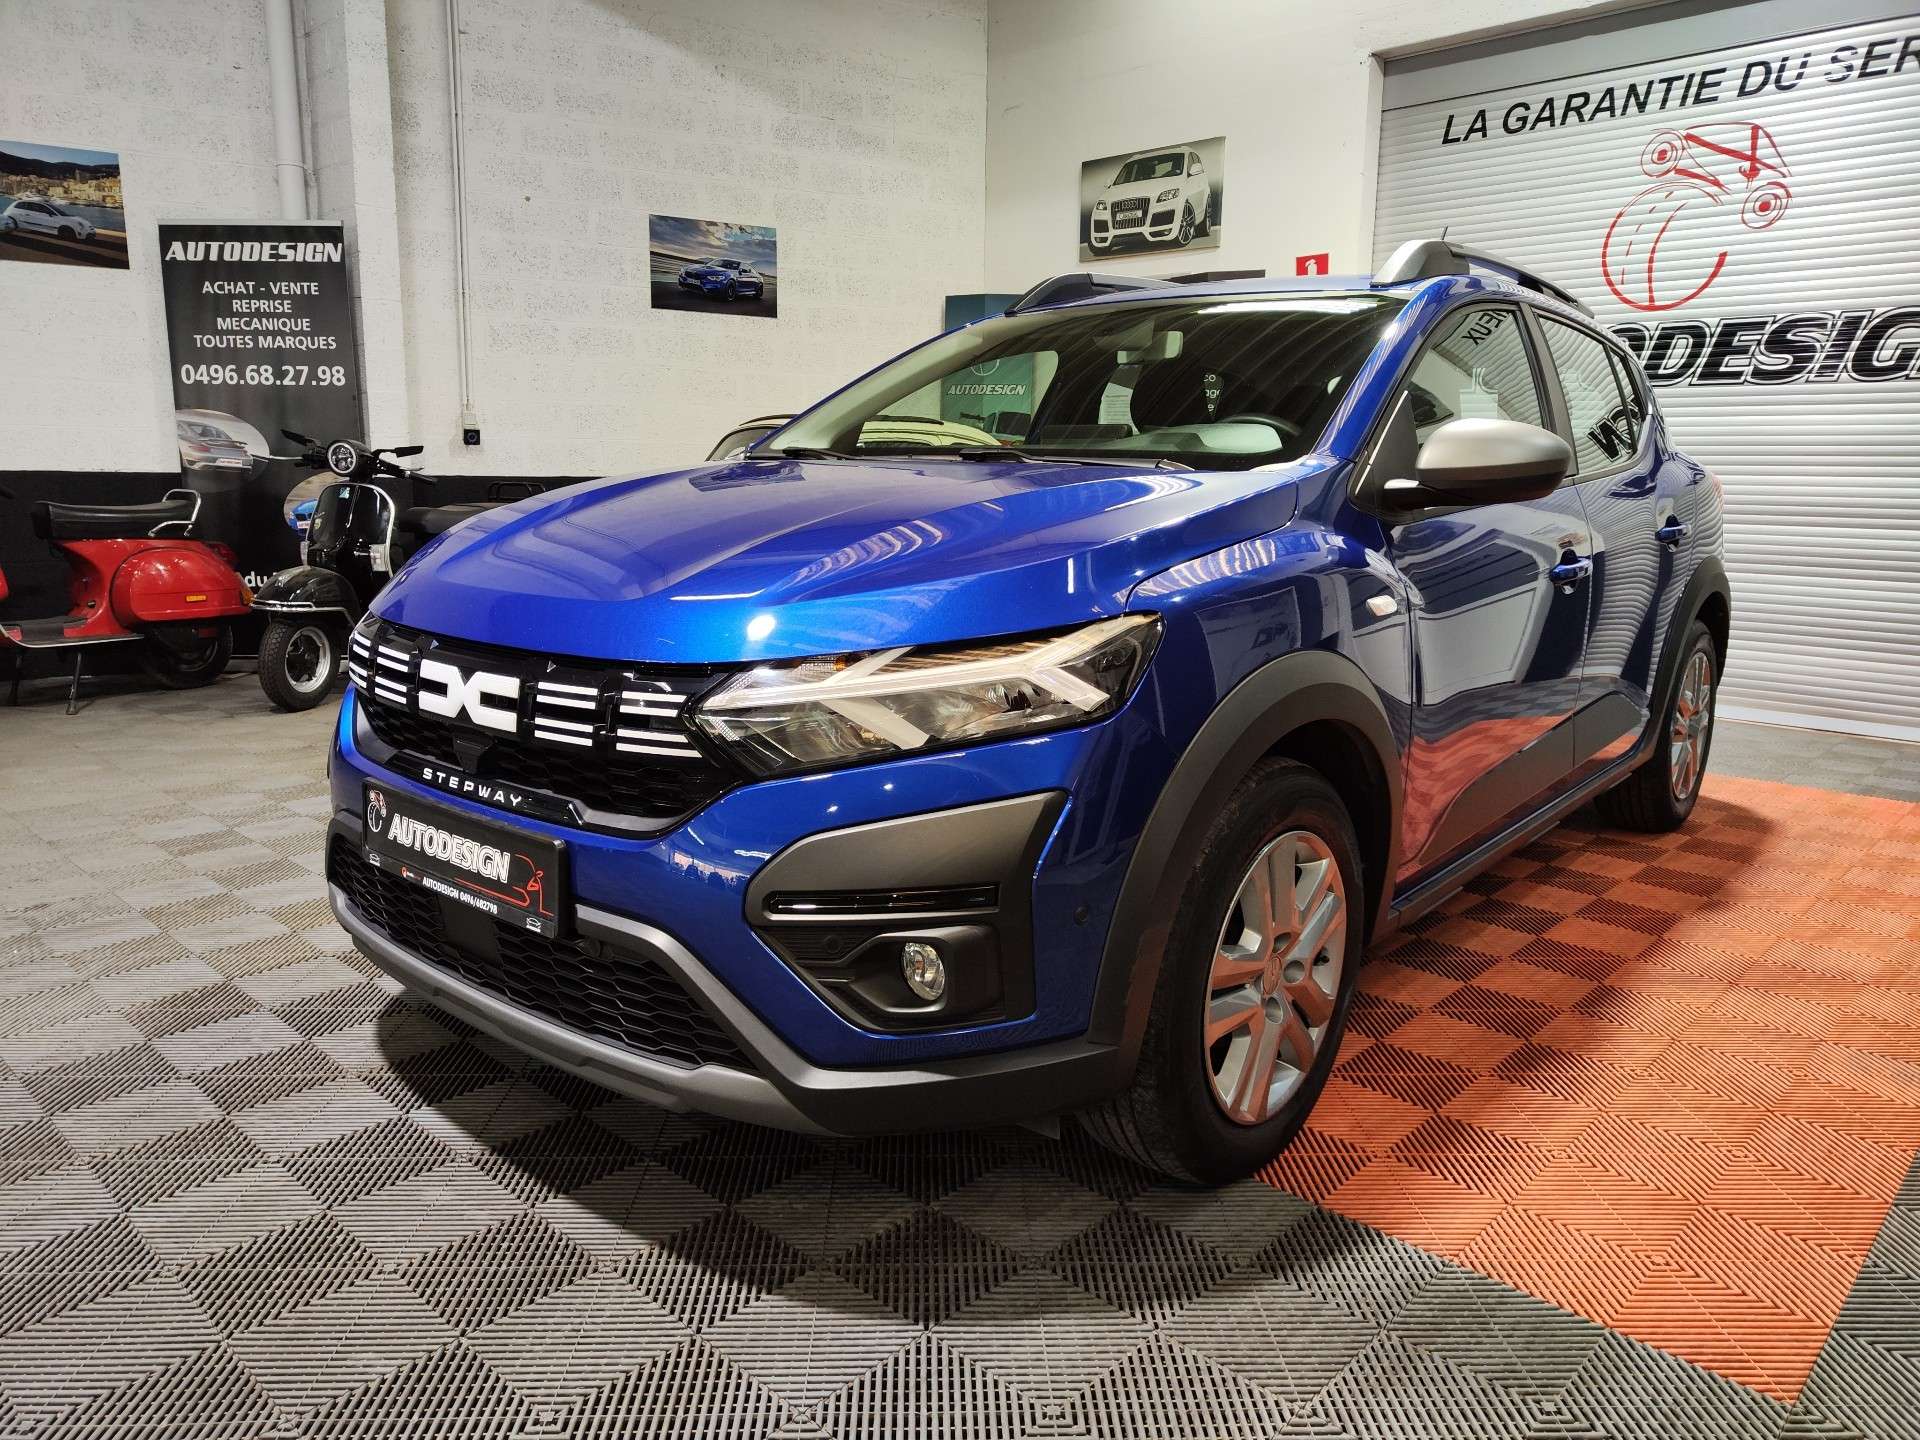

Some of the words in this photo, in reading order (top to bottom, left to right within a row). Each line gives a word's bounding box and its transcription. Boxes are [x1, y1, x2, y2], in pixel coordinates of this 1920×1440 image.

[1442, 109, 1488, 145] LA
[1502, 67, 1728, 135] GARANTIE
[1737, 52, 1811, 98] DU
[165, 241, 343, 263] AUTODESIGN
[202, 281, 255, 294] ACHAT
[269, 282, 320, 295] VENTE
[232, 300, 292, 313] REPRISE
[216, 318, 311, 332] MECANIQUE
[194, 335, 254, 348] TOUTES
[258, 335, 337, 350] MARQUES
[180, 364, 346, 386] 0496.68.27.98
[947, 384, 1026, 395] AUTODESIGN
[422, 767, 522, 807] STEPWAY
[388, 813, 511, 884] AUTODESIGN
[422, 876, 459, 899] AUTODESIGN
